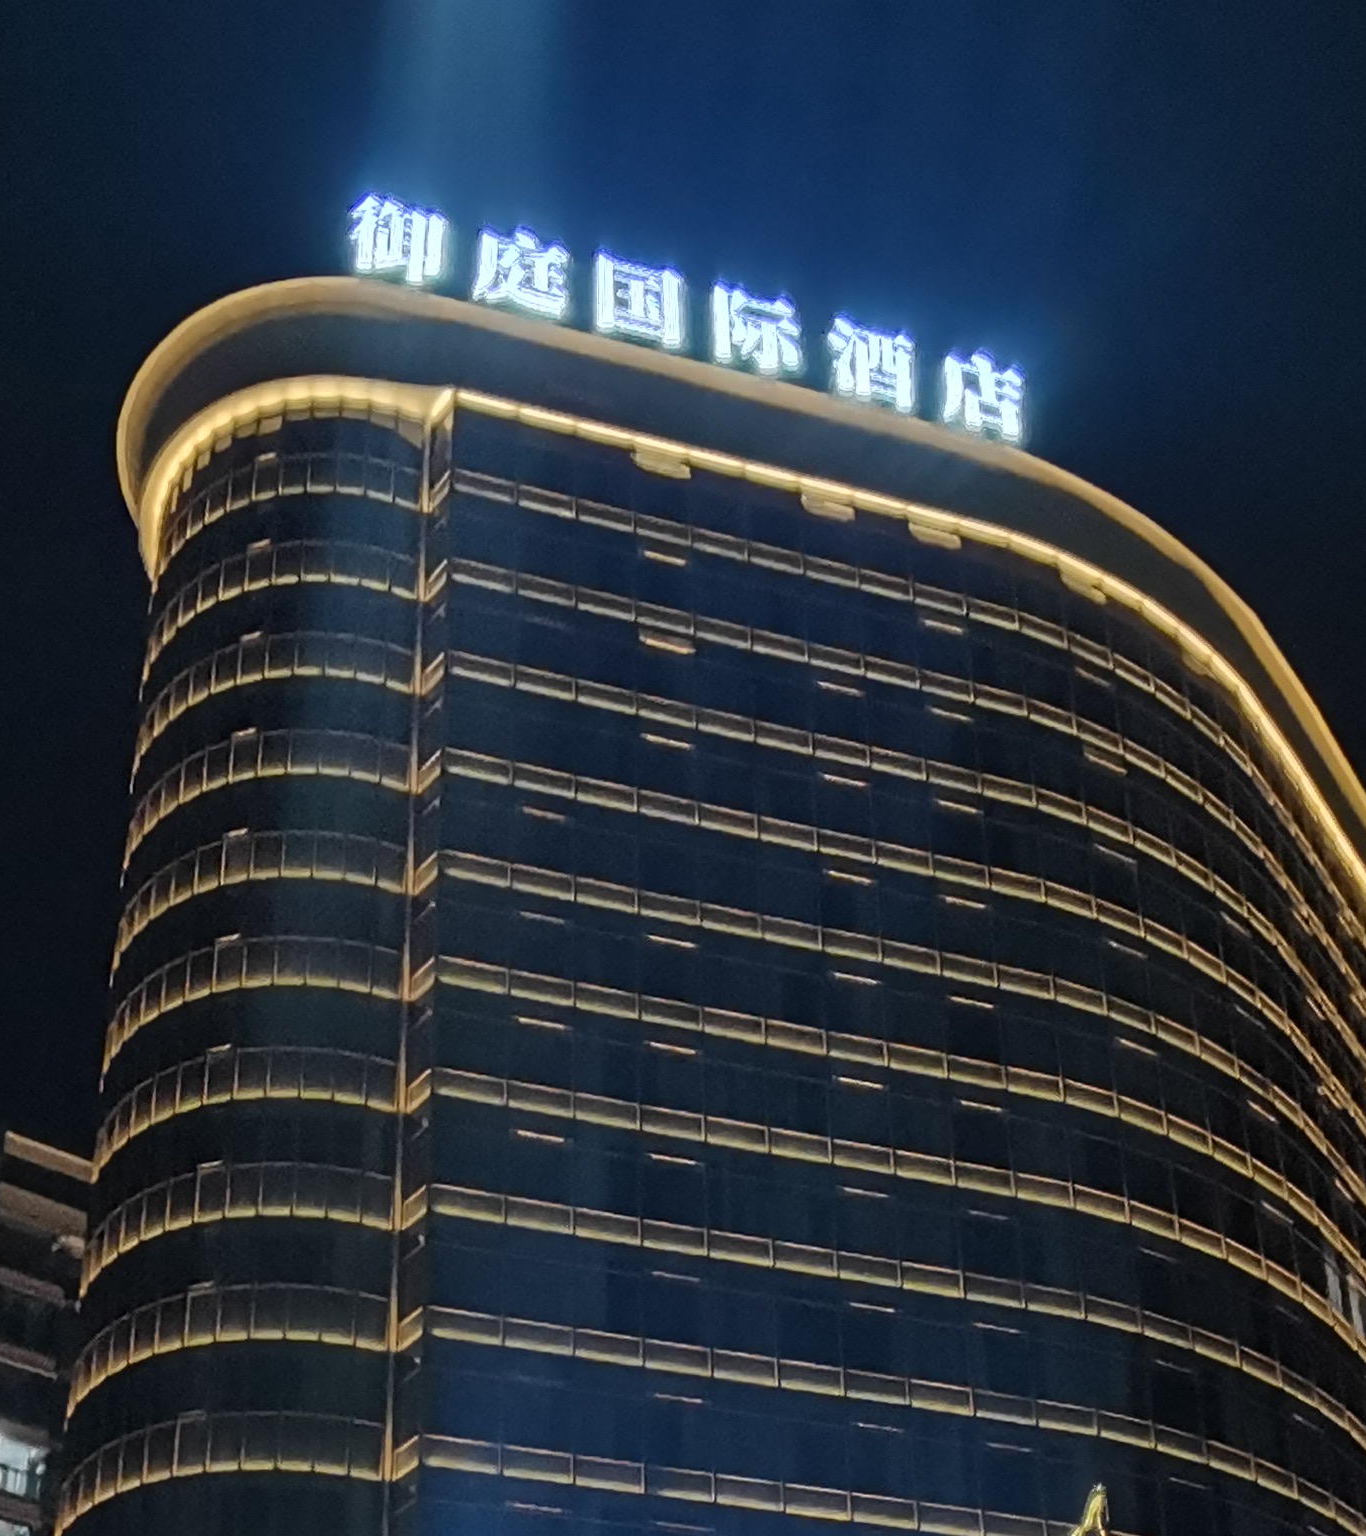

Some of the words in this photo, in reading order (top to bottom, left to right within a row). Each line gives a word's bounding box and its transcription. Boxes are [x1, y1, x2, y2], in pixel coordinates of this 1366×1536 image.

[346, 191, 1027, 447] 御庭国际酒店
